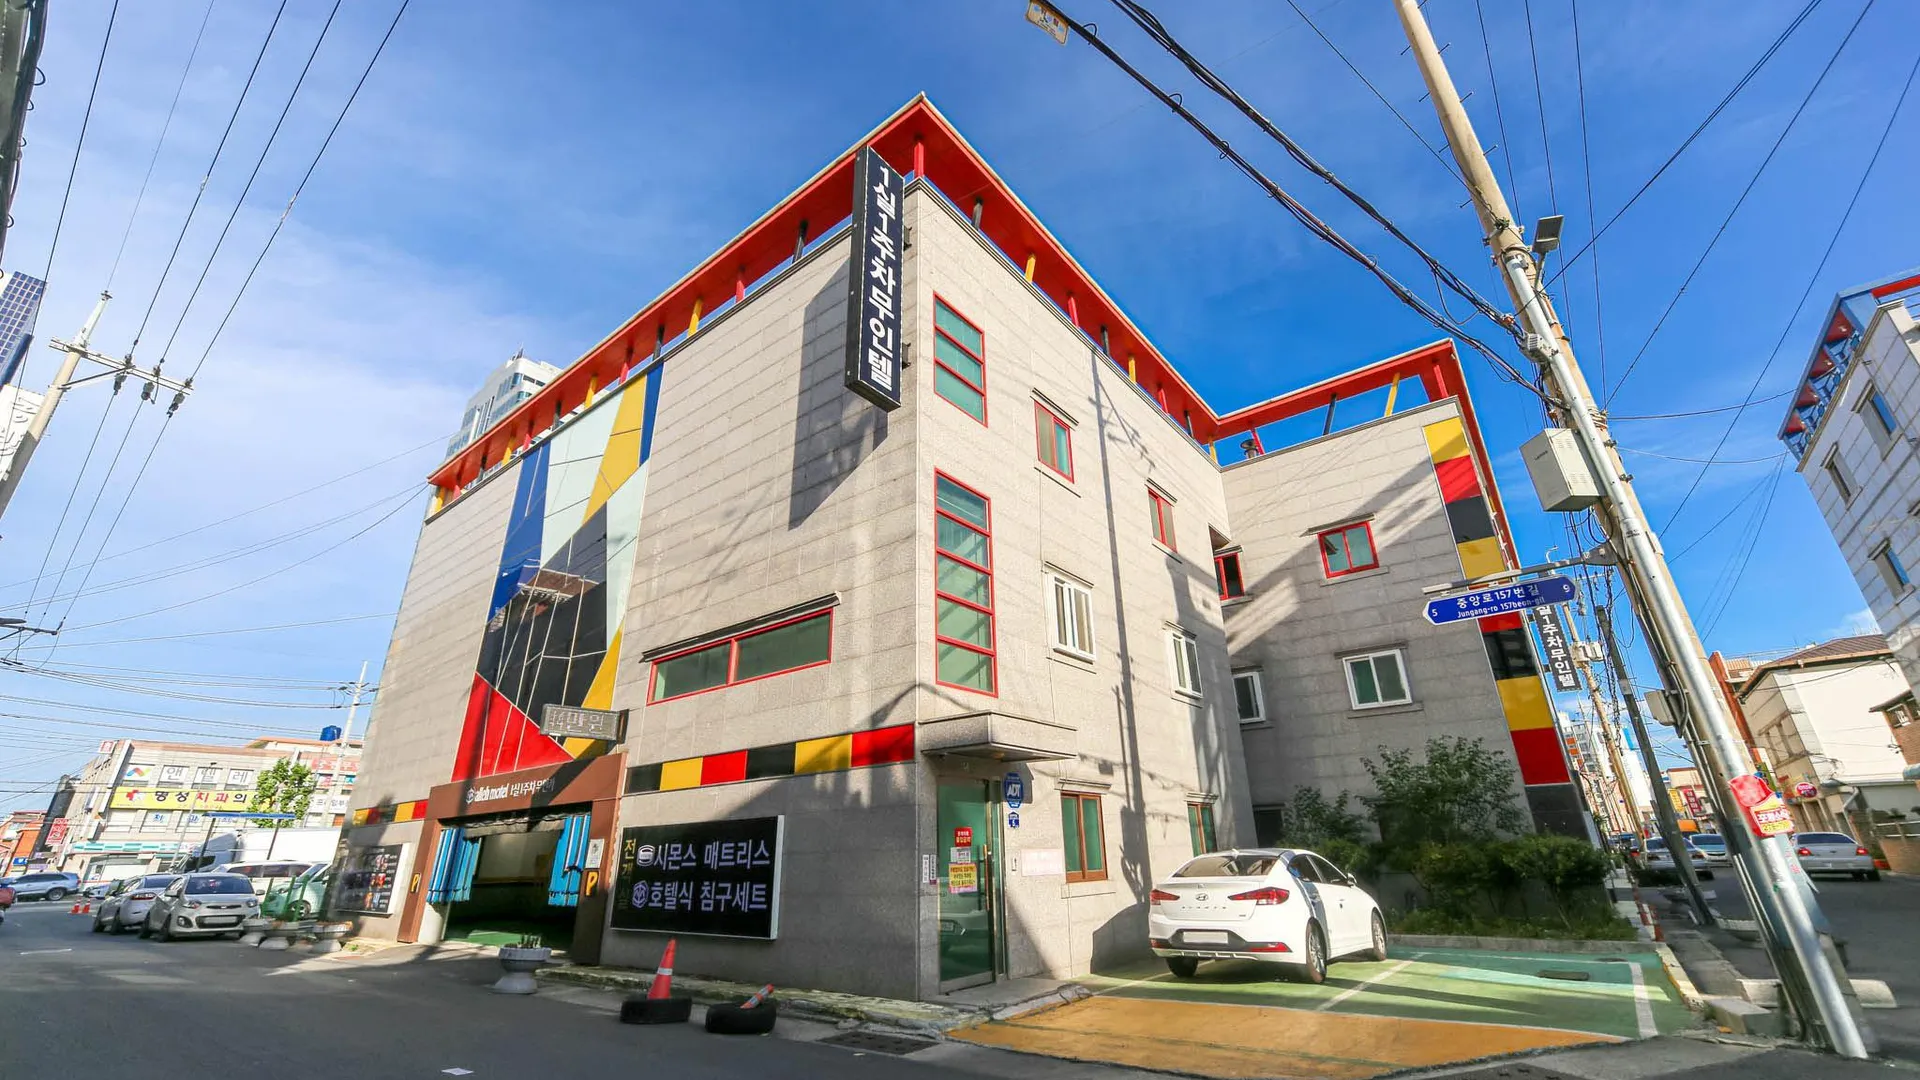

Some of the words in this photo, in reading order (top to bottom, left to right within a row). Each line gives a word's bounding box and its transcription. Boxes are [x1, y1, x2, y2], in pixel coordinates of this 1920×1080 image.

[868, 164, 897, 392] 1실1주차무인텔
[1562, 584, 1571, 593] 9
[1432, 609, 1438, 617] 5
[1457, 605, 1498, 619] Jungang-ro
[489, 782, 509, 800] motel
[1007, 783, 1021, 797] ADT
[653, 843, 697, 870] 시몬스
[704, 839, 771, 870] 매트리스
[585, 871, 599, 896] P
[648, 880, 694, 911] 호텔식
[699, 880, 768, 913] 침구세트
